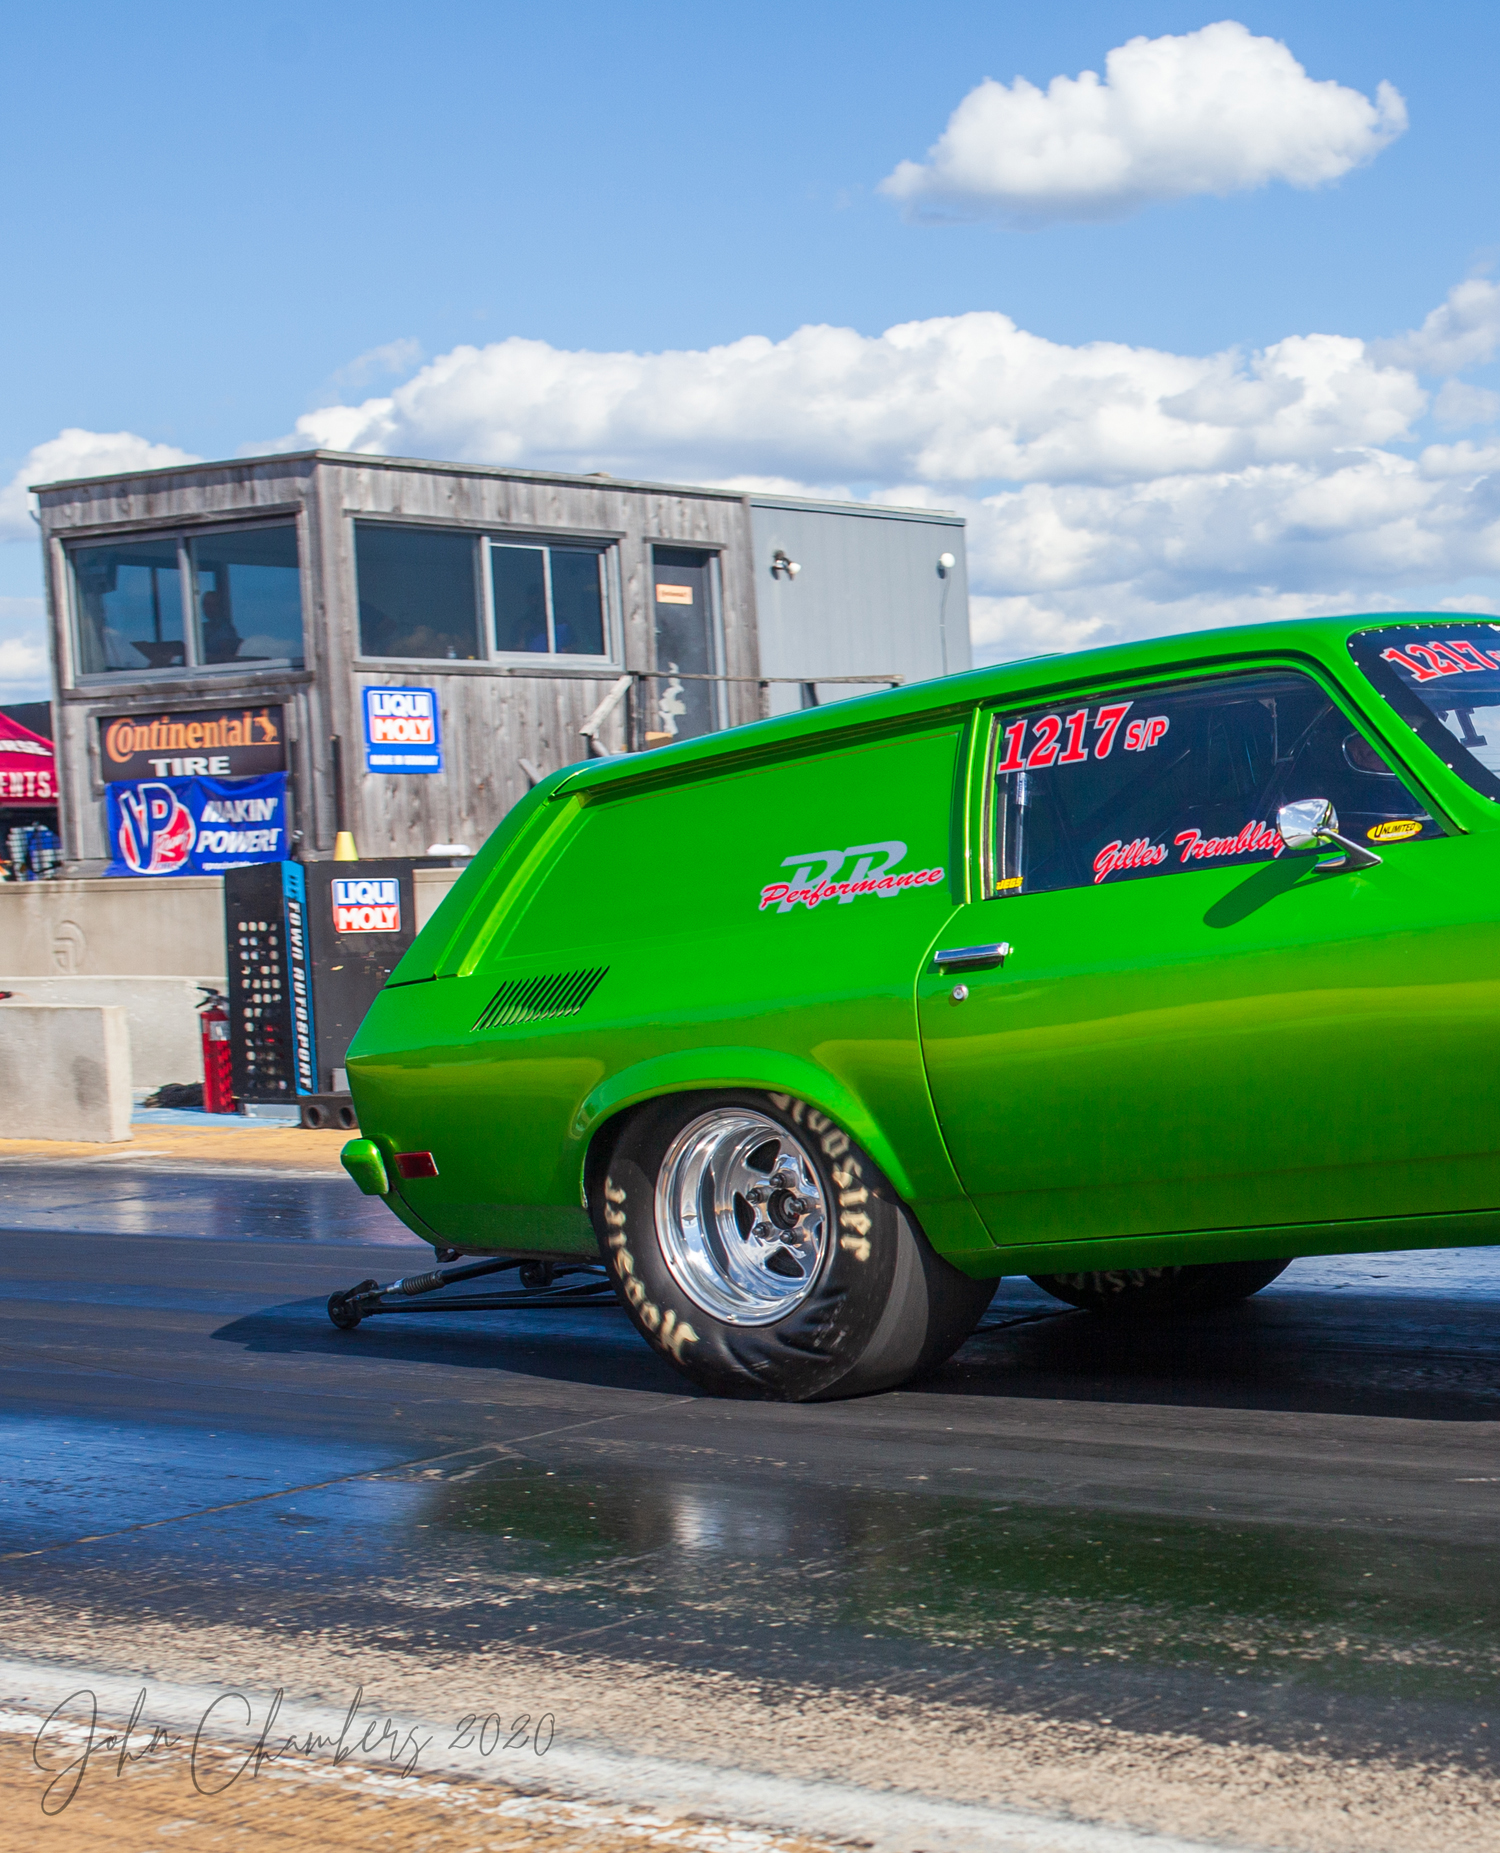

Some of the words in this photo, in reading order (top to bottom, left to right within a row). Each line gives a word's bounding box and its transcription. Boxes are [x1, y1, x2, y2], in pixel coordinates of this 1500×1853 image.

[1380, 640, 1499, 683] 1217
[371, 694, 430, 717] LIQUI
[106, 711, 252, 763] Continental
[374, 718, 431, 741] MOLY
[997, 701, 1134, 774] 1217
[1124, 716, 1170, 752] S/P
[148, 756, 231, 777] TIRE
[201, 797, 278, 823] MAKIN'
[195, 828, 282, 854] POWER!
[1374, 823, 1416, 838] UNLIMITED
[1093, 837, 1168, 884] Gilles
[1174, 820, 1285, 858] Tremblay
[336, 881, 395, 905] LIQUI
[758, 867, 945, 910] Performance
[338, 907, 397, 930] MOLY
